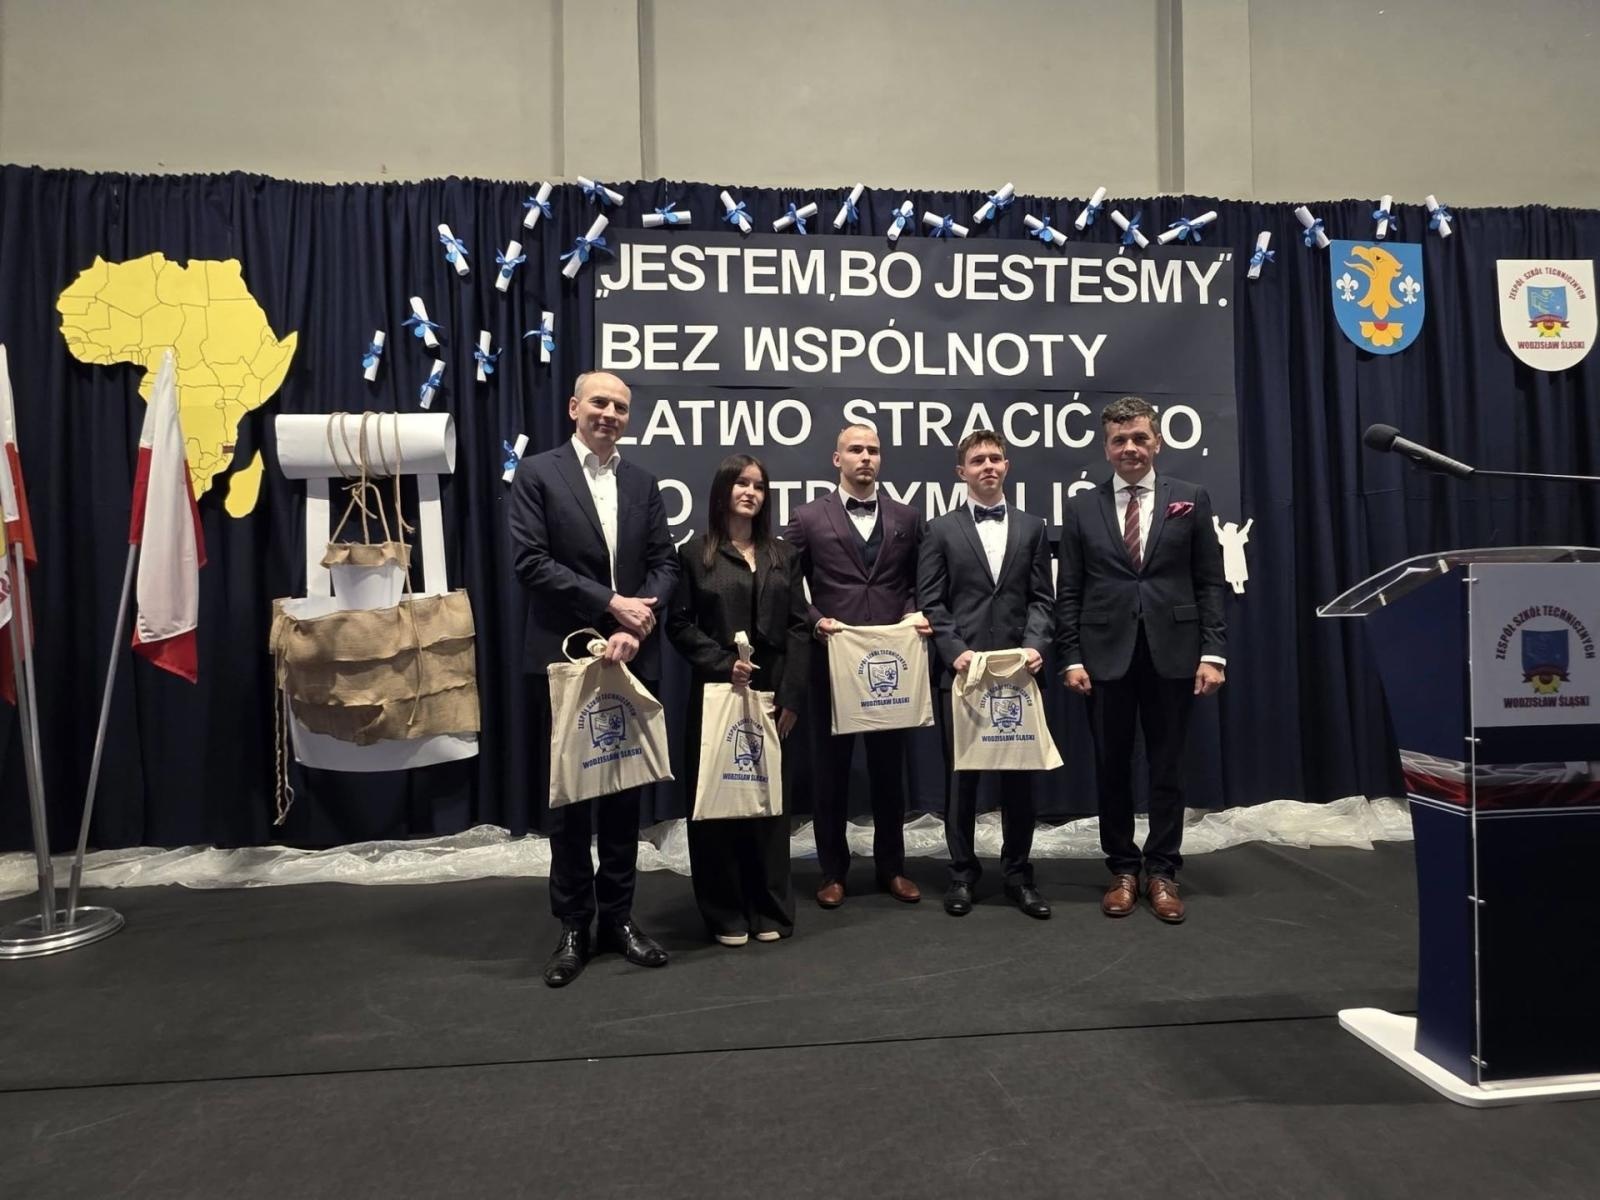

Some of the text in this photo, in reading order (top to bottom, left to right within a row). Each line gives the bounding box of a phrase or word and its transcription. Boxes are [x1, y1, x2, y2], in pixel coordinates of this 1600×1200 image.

[1508, 277, 1525, 300] ZESPÓŁ
[1545, 267, 1587, 300] TECHNICZNYCH
[602, 318, 1108, 377] BEZ WSPÓLNOTY
[1517, 340, 1585, 350] WODZISŁAW ŚLĄSKI
[615, 399, 812, 446] ATWO
[1496, 605, 1596, 660] ZESPÓŁ SZKÓŁ TECHNICZNYCH
[1504, 695, 1590, 709] WODZISŁAW ŚLĄSKI
